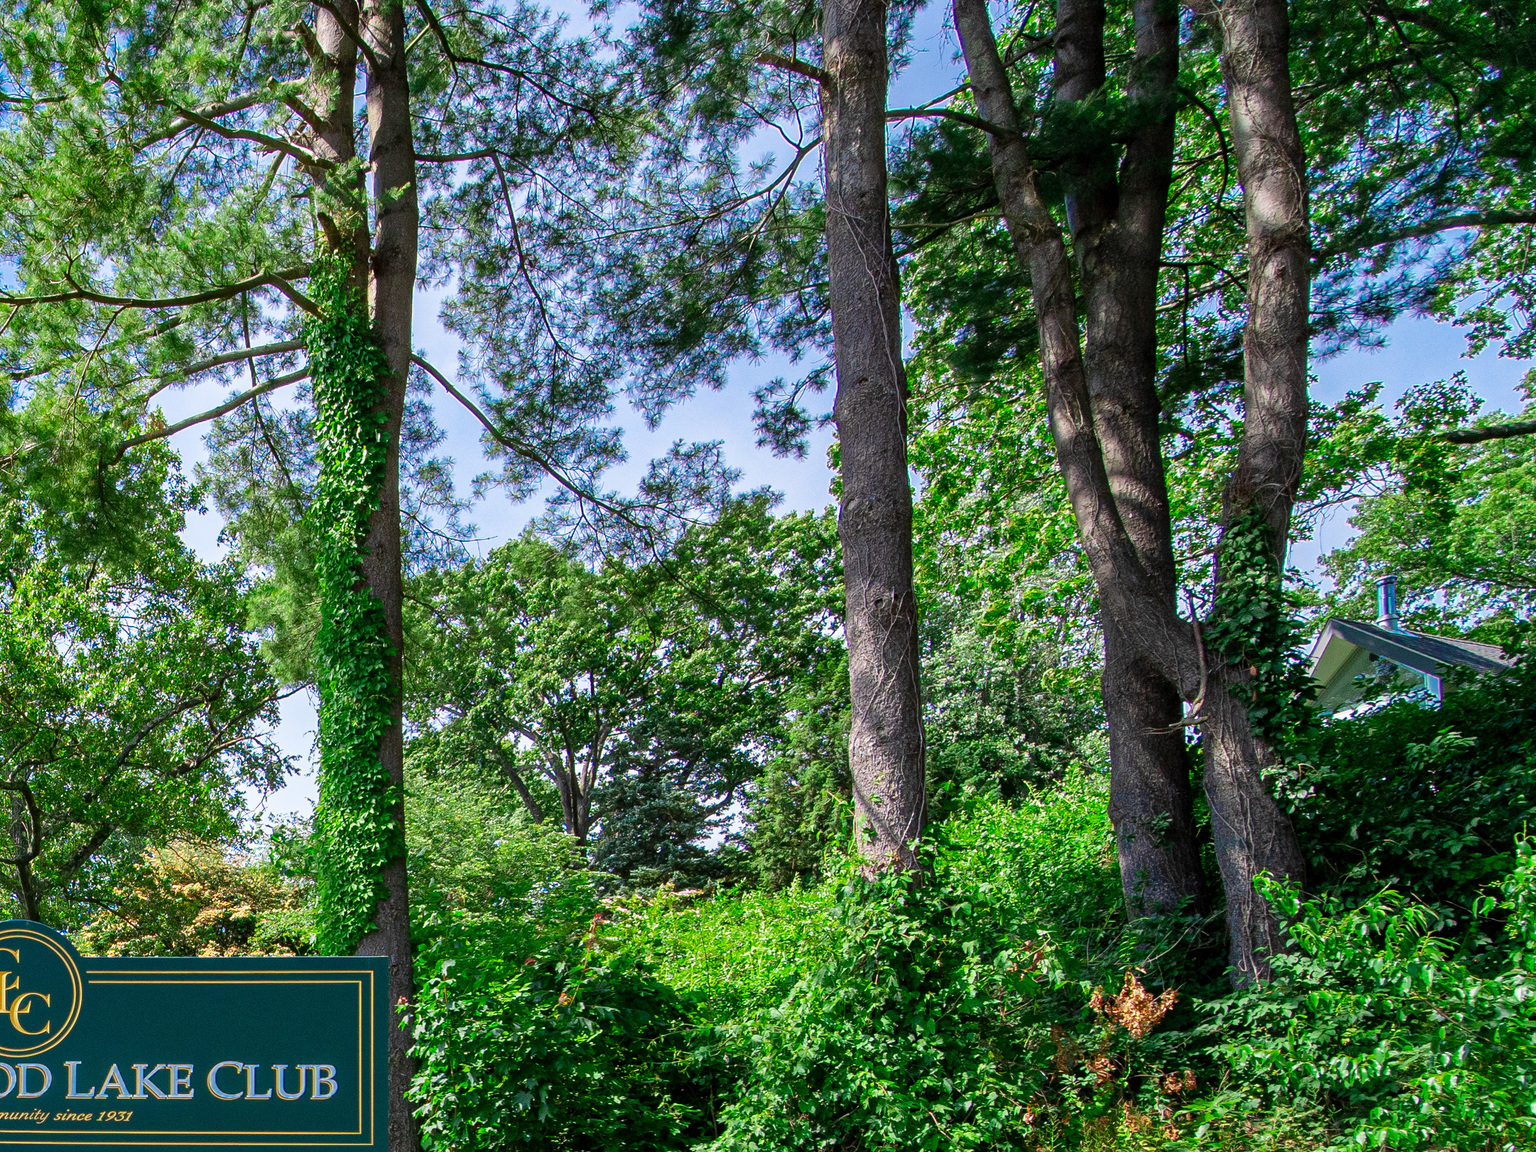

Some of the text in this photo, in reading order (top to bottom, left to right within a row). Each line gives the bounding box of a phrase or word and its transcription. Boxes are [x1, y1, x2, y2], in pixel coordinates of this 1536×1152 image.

[64, 1060, 195, 1100] LAKE
[206, 1060, 339, 1101] CLUB
[53, 1108, 92, 1122] since
[96, 1110, 134, 1122] 1931
